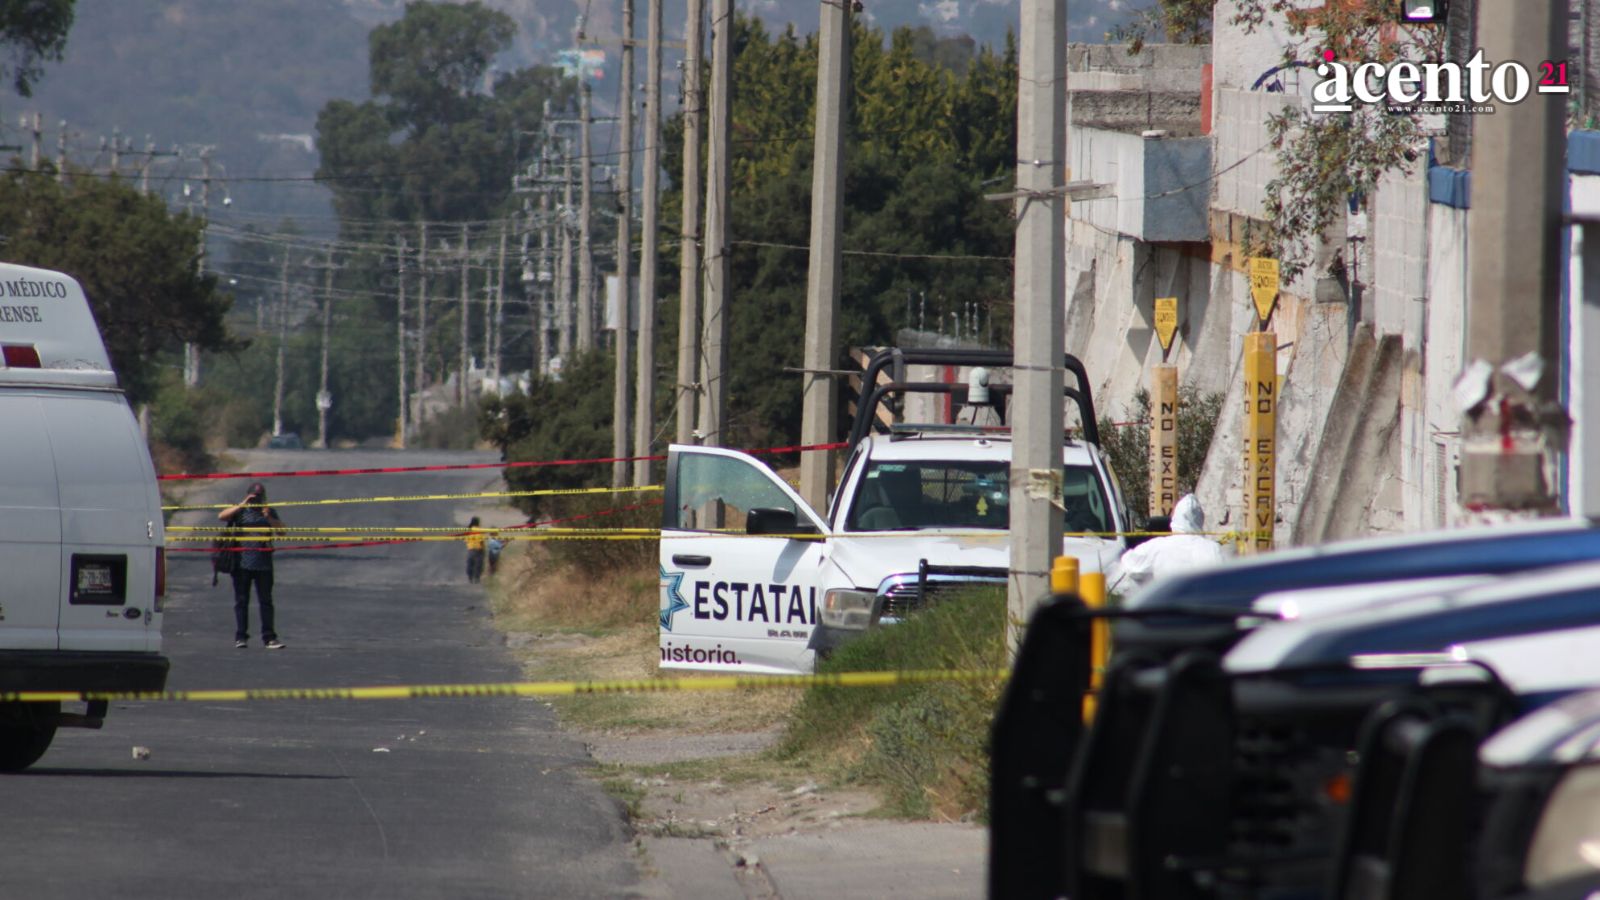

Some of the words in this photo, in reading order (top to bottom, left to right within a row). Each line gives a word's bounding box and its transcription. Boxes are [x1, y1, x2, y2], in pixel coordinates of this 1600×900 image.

[6, 277, 67, 298] MÉDICO
[1257, 381, 1273, 413] NO
[1161, 402, 1174, 431] NO
